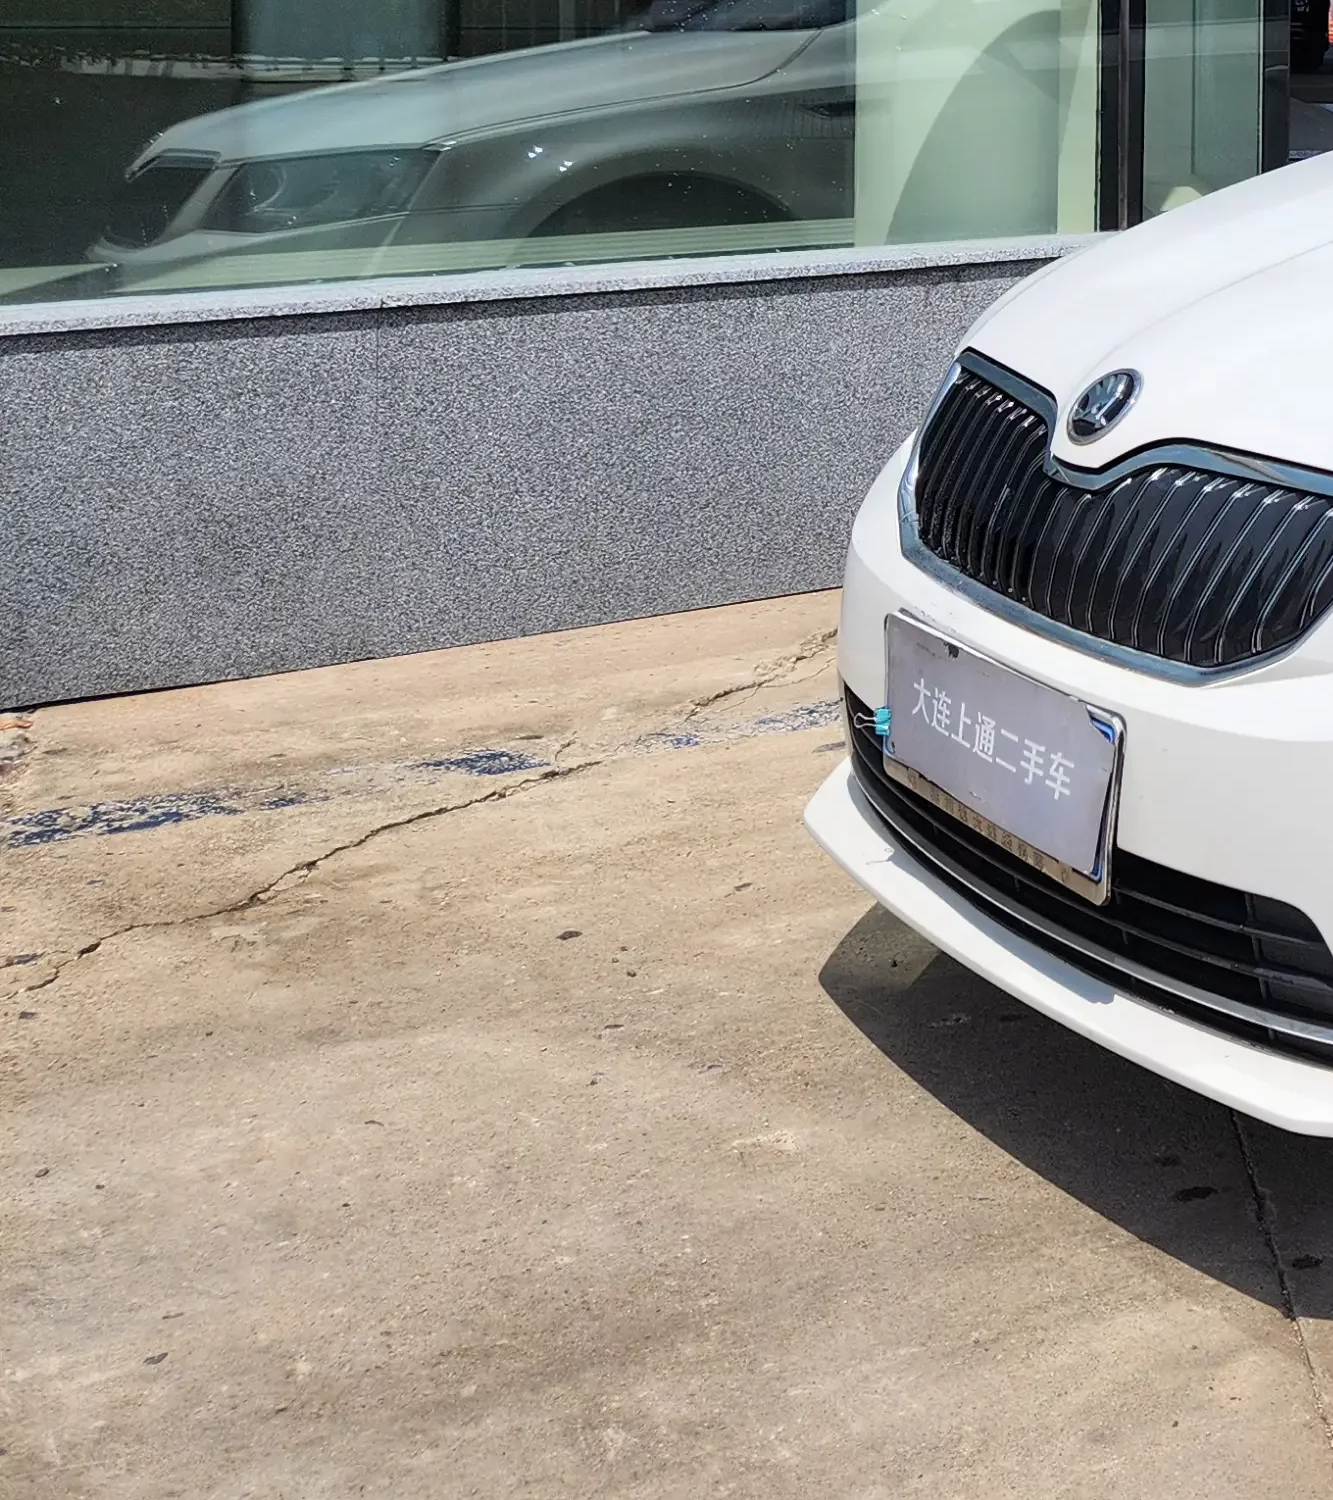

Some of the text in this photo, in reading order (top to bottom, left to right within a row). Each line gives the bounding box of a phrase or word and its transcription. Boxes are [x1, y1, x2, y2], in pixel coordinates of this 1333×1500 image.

[912, 677, 1075, 800] 大连上通二手车
